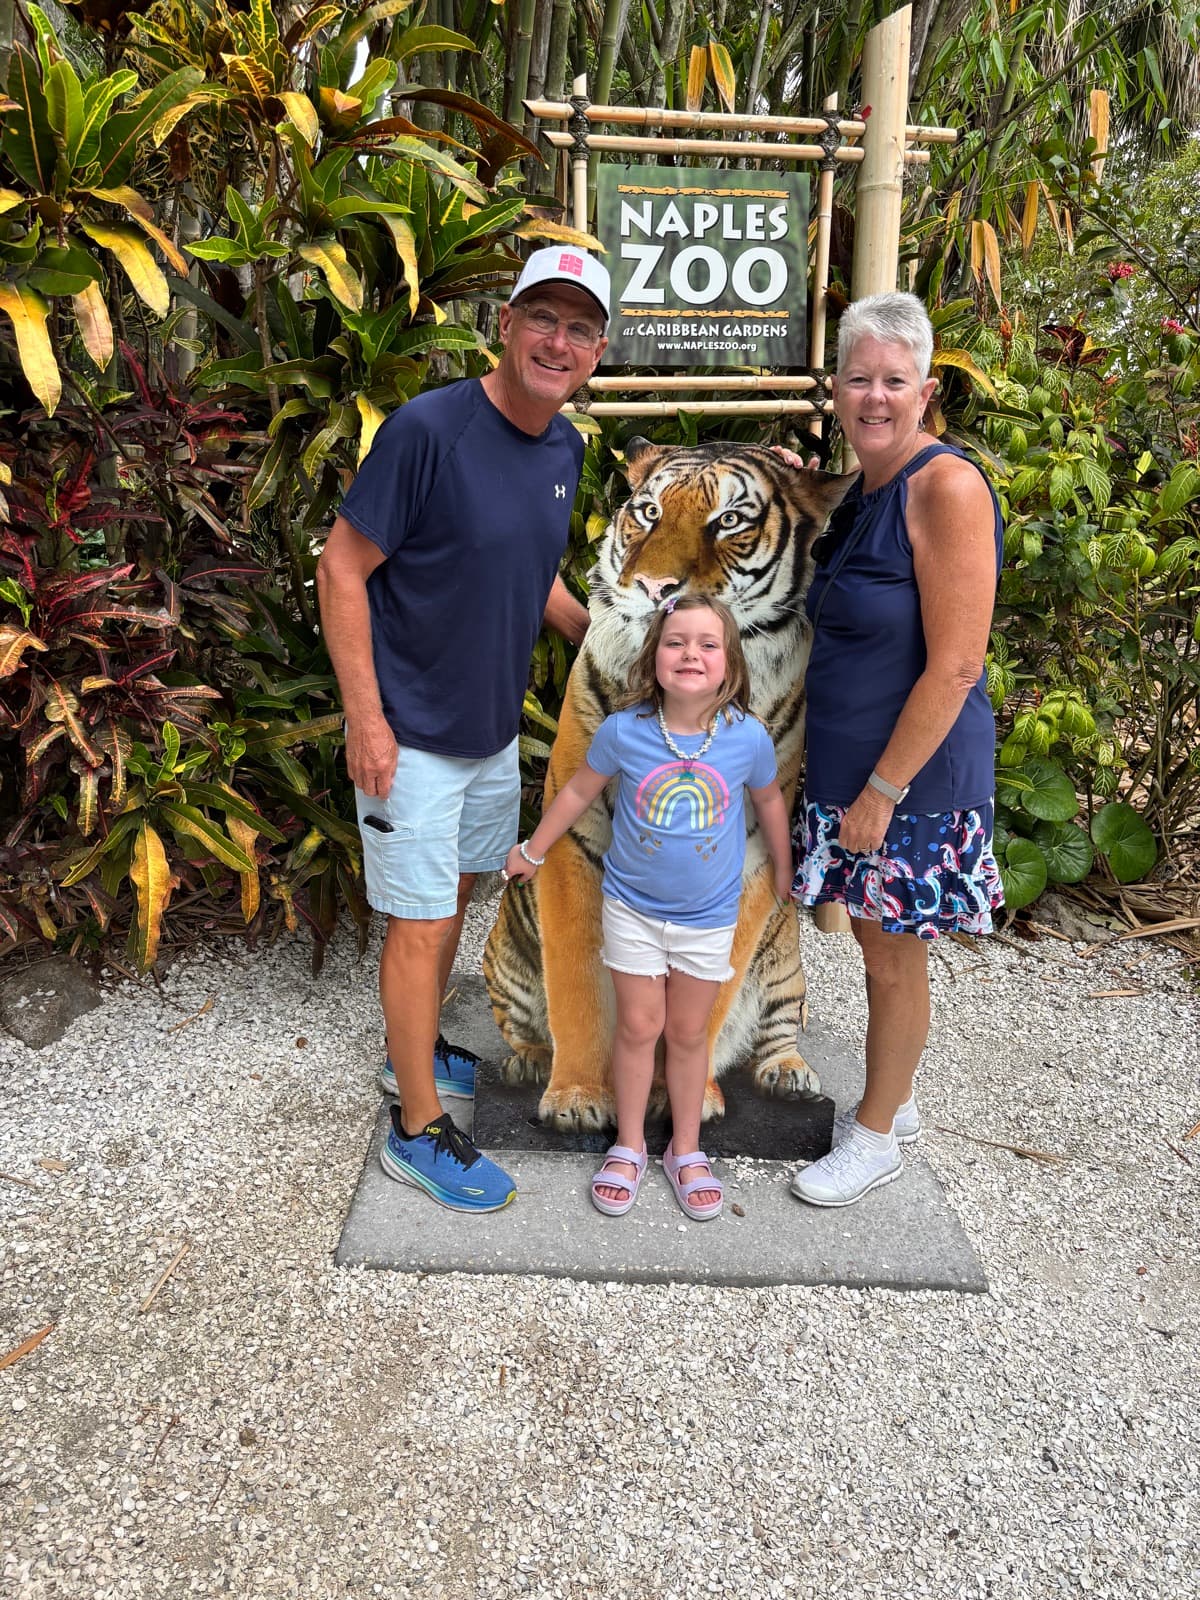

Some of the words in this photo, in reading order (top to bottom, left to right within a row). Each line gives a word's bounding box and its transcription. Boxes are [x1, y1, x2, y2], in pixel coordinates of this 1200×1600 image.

[620, 200, 789, 241] NAPLES
[619, 243, 788, 306] ZOO
[622, 325, 635, 337] at
[636, 323, 719, 337] CARIBBEAN
[723, 324, 788, 337] GARDENS
[657, 341, 757, 352] www.NAPLESZOO.org
